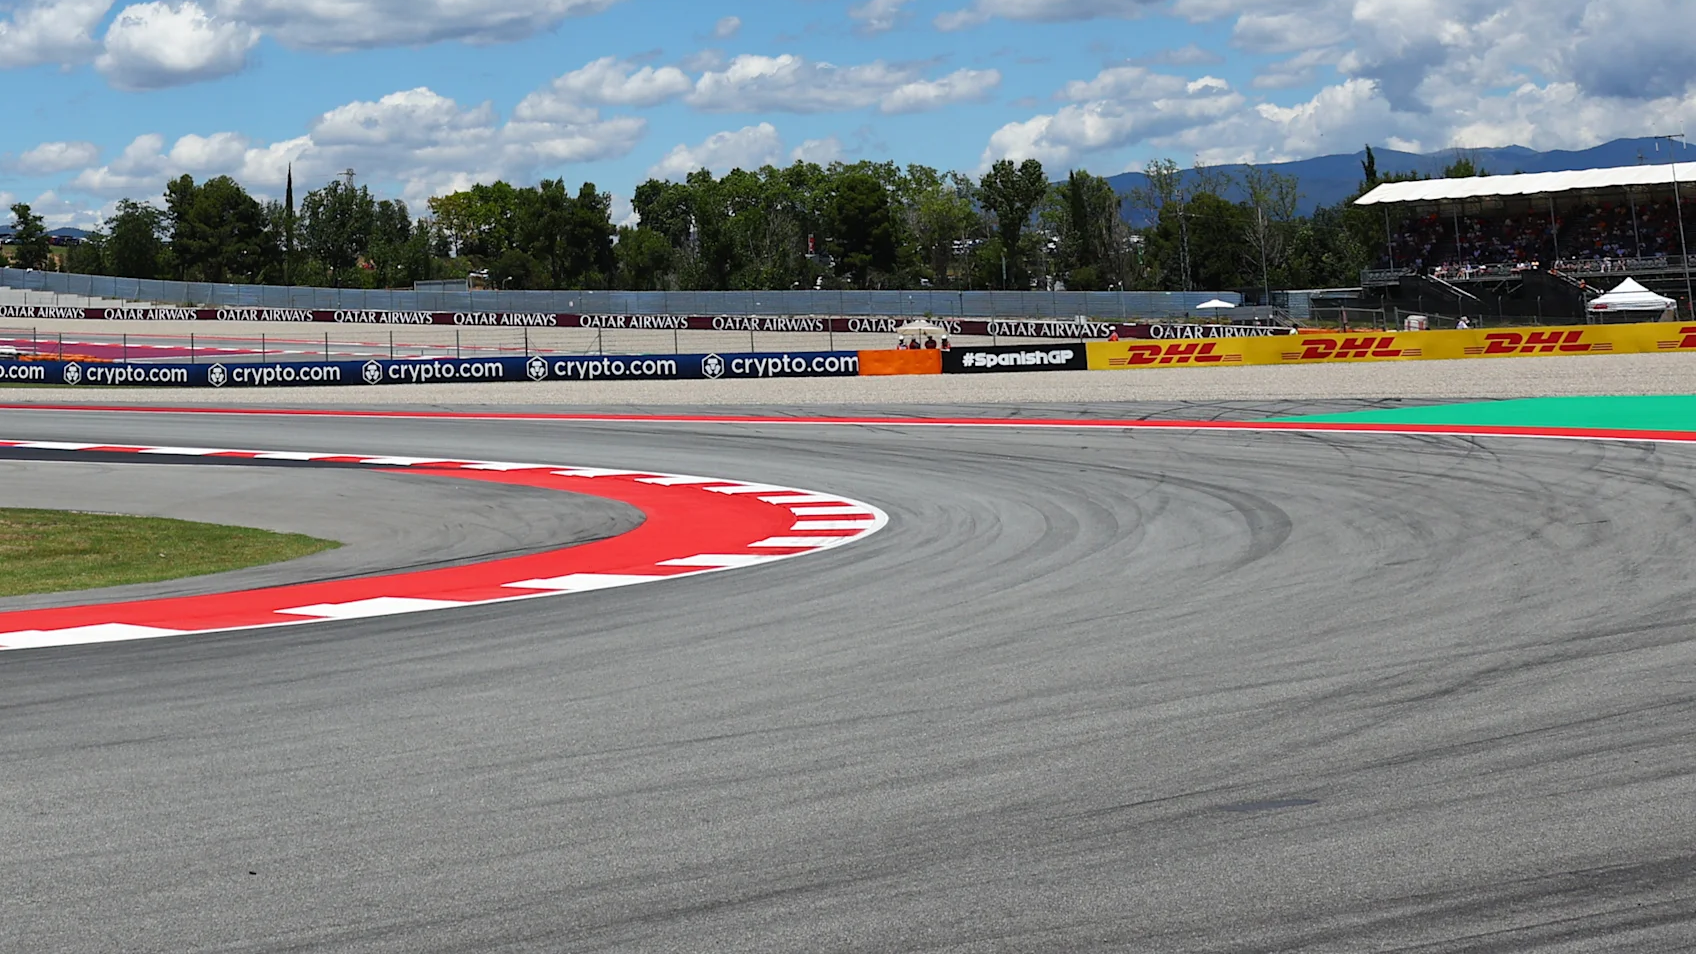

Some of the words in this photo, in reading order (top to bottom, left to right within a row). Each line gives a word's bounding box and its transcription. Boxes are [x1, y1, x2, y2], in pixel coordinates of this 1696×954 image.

[38, 307, 86, 319] AIRWAYS
[104, 308, 143, 320] QATAR
[146, 309, 197, 321] AIRWAYS
[217, 309, 259, 321] QATAR
[263, 309, 313, 322] AIRWAYS
[334, 310, 377, 323] QATAR
[380, 312, 433, 324] AIRWAYS
[454, 313, 497, 325] QATAR
[501, 313, 557, 326] AIRWAYS
[580, 315, 625, 327] QATAR
[629, 316, 688, 329] AIRWAYS
[712, 317, 759, 330] QATAR
[763, 318, 824, 331] AIRWAYS
[848, 319, 896, 332] QATAR
[987, 321, 1037, 336] QATAR
[1041, 322, 1110, 337] AIRWAYS
[1150, 324, 1204, 339] QATAR
[1208, 327, 1275, 338] AIRWAYS
[1301, 336, 1402, 359] DHL
[1483, 330, 1592, 354] DHL
[962, 349, 1074, 369] #SpanishGP
[1127, 342, 1224, 365] DHL
[388, 360, 504, 382] crypto.com
[554, 356, 677, 379] crypto.com
[731, 353, 859, 377] crypto.com
[86, 364, 188, 383] crypto.com
[232, 363, 341, 384] crypto.com
